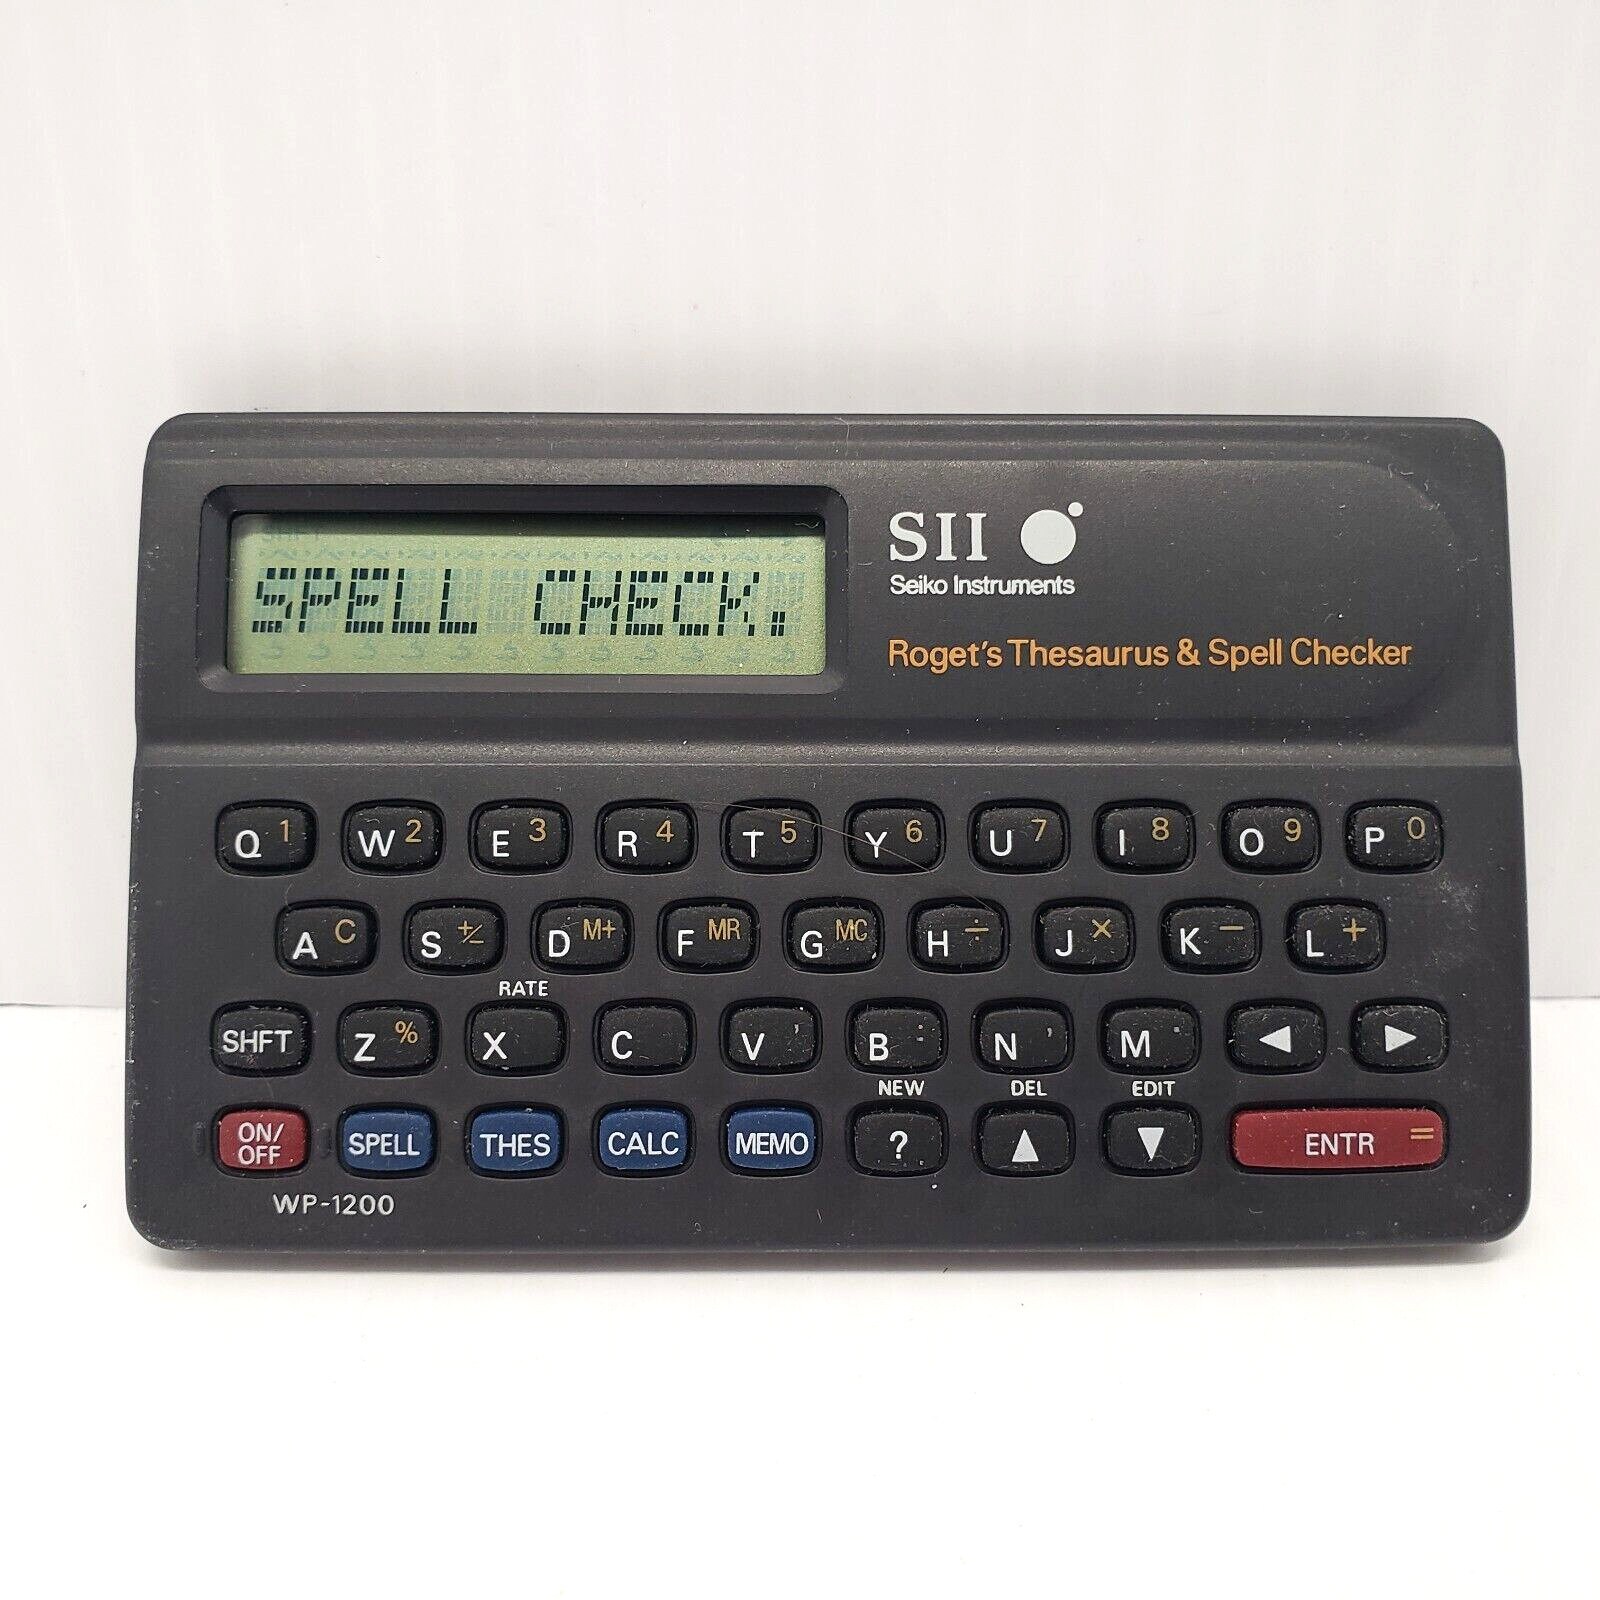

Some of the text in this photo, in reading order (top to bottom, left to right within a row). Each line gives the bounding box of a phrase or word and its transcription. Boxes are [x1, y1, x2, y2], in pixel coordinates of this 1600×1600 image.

[889, 511, 988, 562] SII
[890, 574, 1076, 596] Seiko Instruments
[251, 567, 787, 637] SPELL CHECK.
[889, 637, 1413, 674] Roget's Thesaurus & Spell Checker
[279, 819, 289, 842] 1
[405, 818, 422, 843] 2
[528, 817, 547, 842] 3
[656, 819, 675, 843] 4
[781, 820, 797, 844] 5
[905, 819, 923, 843] 6
[1031, 817, 1047, 842] 7
[1151, 816, 1170, 841] 8
[1239, 827, 1264, 857] O
[1284, 818, 1302, 842] 9
[1365, 826, 1385, 854] P
[234, 829, 262, 859] Q
[357, 829, 396, 858] W
[492, 829, 510, 858] E
[618, 830, 638, 858] R
[742, 828, 765, 859] T
[864, 831, 888, 859] Y
[989, 829, 1012, 857] U
[334, 918, 356, 944] C
[583, 918, 616, 941] M+
[677, 929, 695, 957] F
[708, 917, 741, 941] MR
[835, 918, 868, 942] MC
[1055, 929, 1073, 957] J
[1179, 927, 1202, 955] K
[292, 931, 319, 960] A
[421, 930, 442, 959] S
[548, 929, 571, 958] D
[800, 930, 823, 959] G
[927, 929, 949, 958] H
[1306, 929, 1325, 958] L
[498, 980, 549, 997] RATE
[222, 1029, 293, 1054] SHFT
[394, 1020, 418, 1044] %
[482, 1031, 508, 1061] X
[611, 1030, 633, 1060] C
[1120, 1030, 1151, 1059] M
[353, 1032, 376, 1062] Z
[741, 1032, 765, 1061] V
[869, 1032, 889, 1062] B
[994, 1032, 1017, 1061] N
[878, 1079, 925, 1097] NEW
[1010, 1079, 1048, 1097] DEL
[1131, 1080, 1176, 1097] EDIT
[238, 1121, 285, 1144] ON/
[347, 1132, 421, 1156] SPELL
[479, 1133, 551, 1158] THES
[607, 1131, 679, 1156] CALC
[735, 1132, 809, 1156] MEMO
[889, 1130, 908, 1160] ?
[1305, 1132, 1375, 1156] ENTR
[237, 1144, 282, 1166] OFF
[272, 1193, 395, 1216] WP-1200
